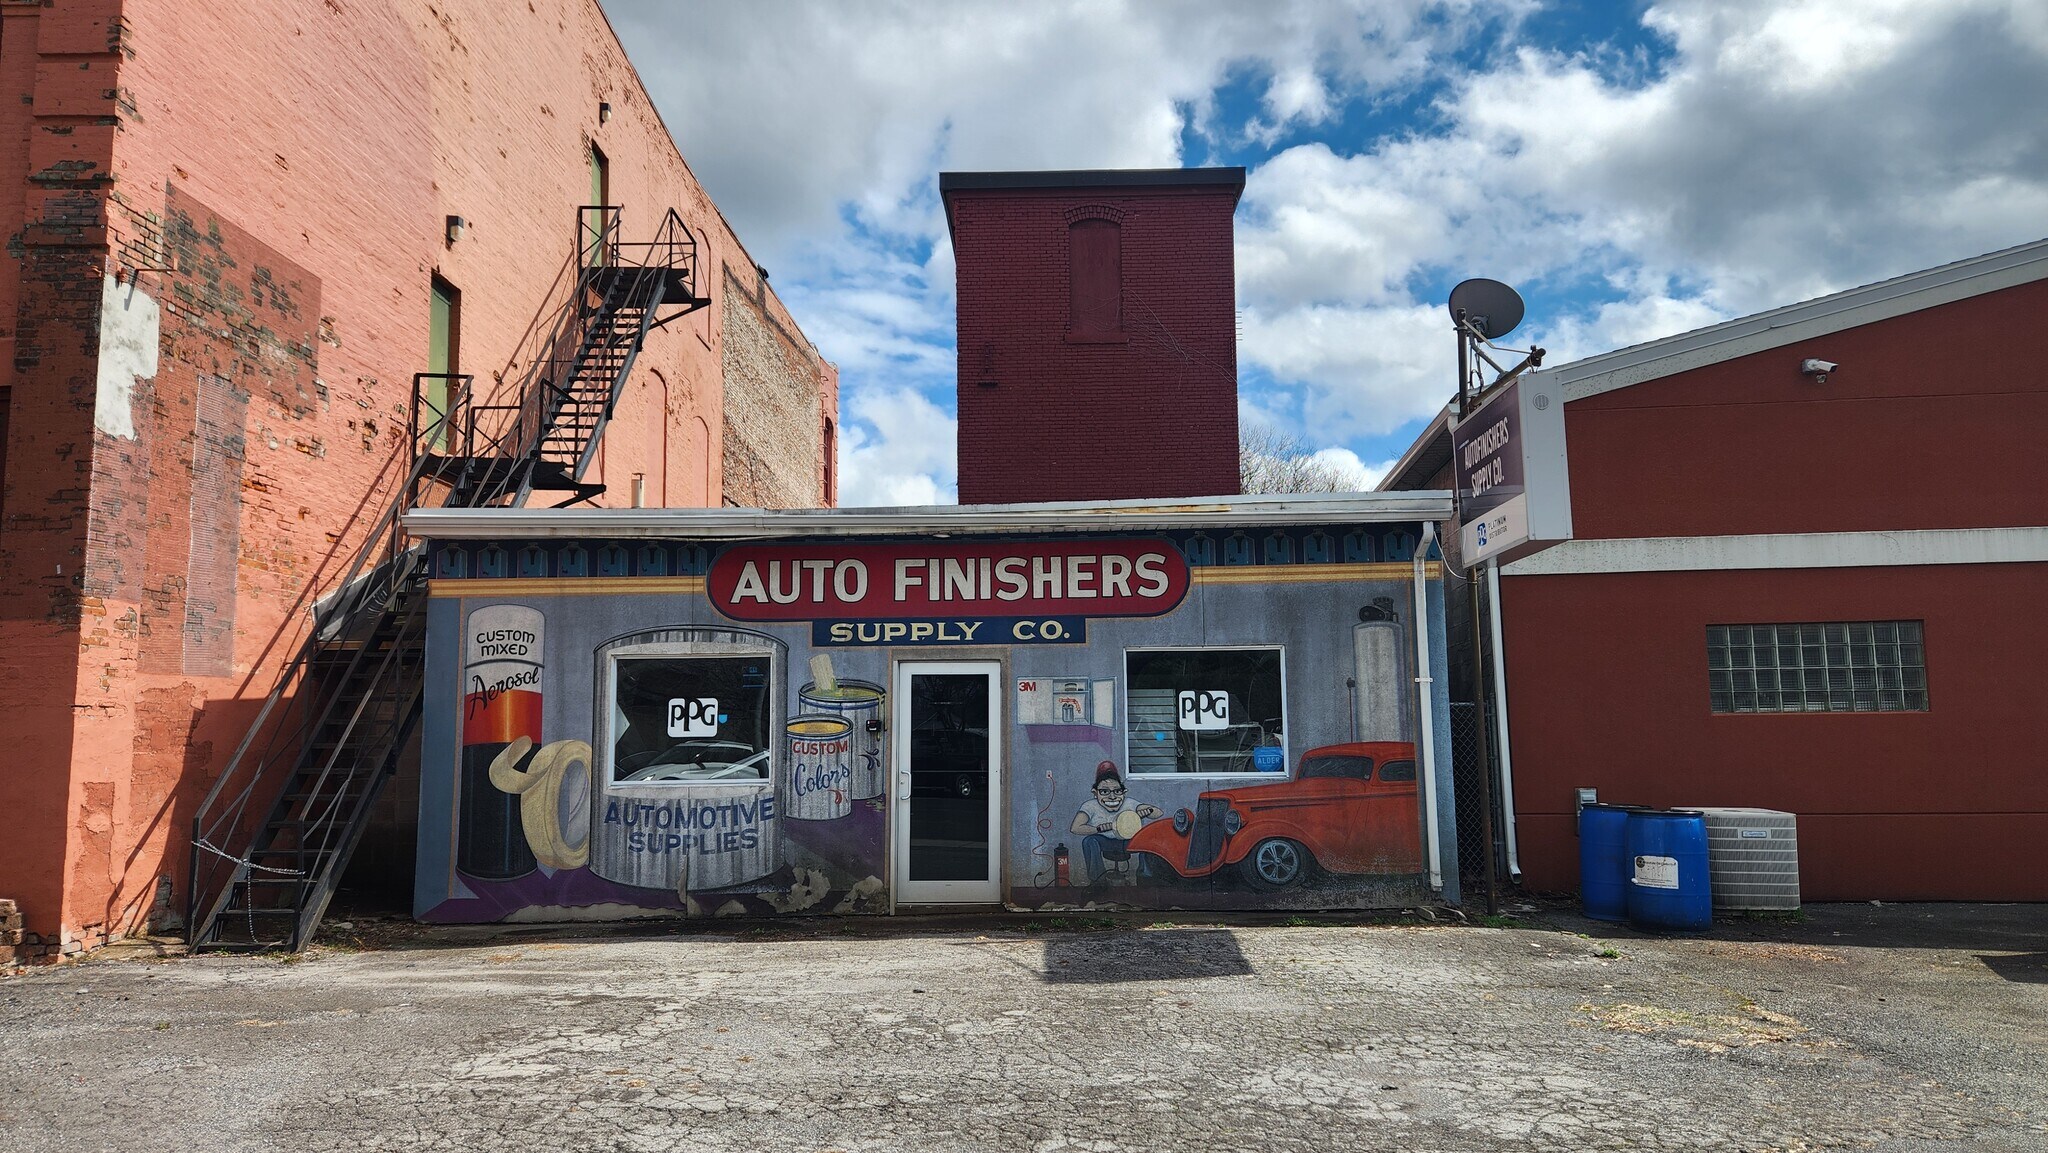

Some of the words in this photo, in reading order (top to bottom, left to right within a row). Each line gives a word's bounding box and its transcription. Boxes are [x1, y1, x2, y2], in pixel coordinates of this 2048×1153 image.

[1464, 416, 1510, 471] AUTOFINISHERS
[1471, 462, 1493, 499] SUPPLY
[1492, 456, 1505, 486] CO.
[730, 558, 869, 604] AUTO
[894, 552, 1170, 601] FINISHERS
[476, 630, 536, 644] CUSTOM
[830, 621, 984, 643] SUPPLY
[1012, 619, 1071, 641] CO.
[481, 643, 528, 657] MIXED
[469, 666, 540, 721] Aerosol
[1018, 681, 1037, 692] 3M
[670, 697, 717, 732] PPG
[1181, 690, 1227, 725] PPG
[792, 741, 849, 756] CUSTOM
[1257, 757, 1281, 765] ALDER
[794, 763, 851, 797] Colors
[604, 797, 776, 830] AUTOMOTIVE
[628, 828, 760, 856] SUPPLIES
[1057, 857, 1068, 866] 3M
